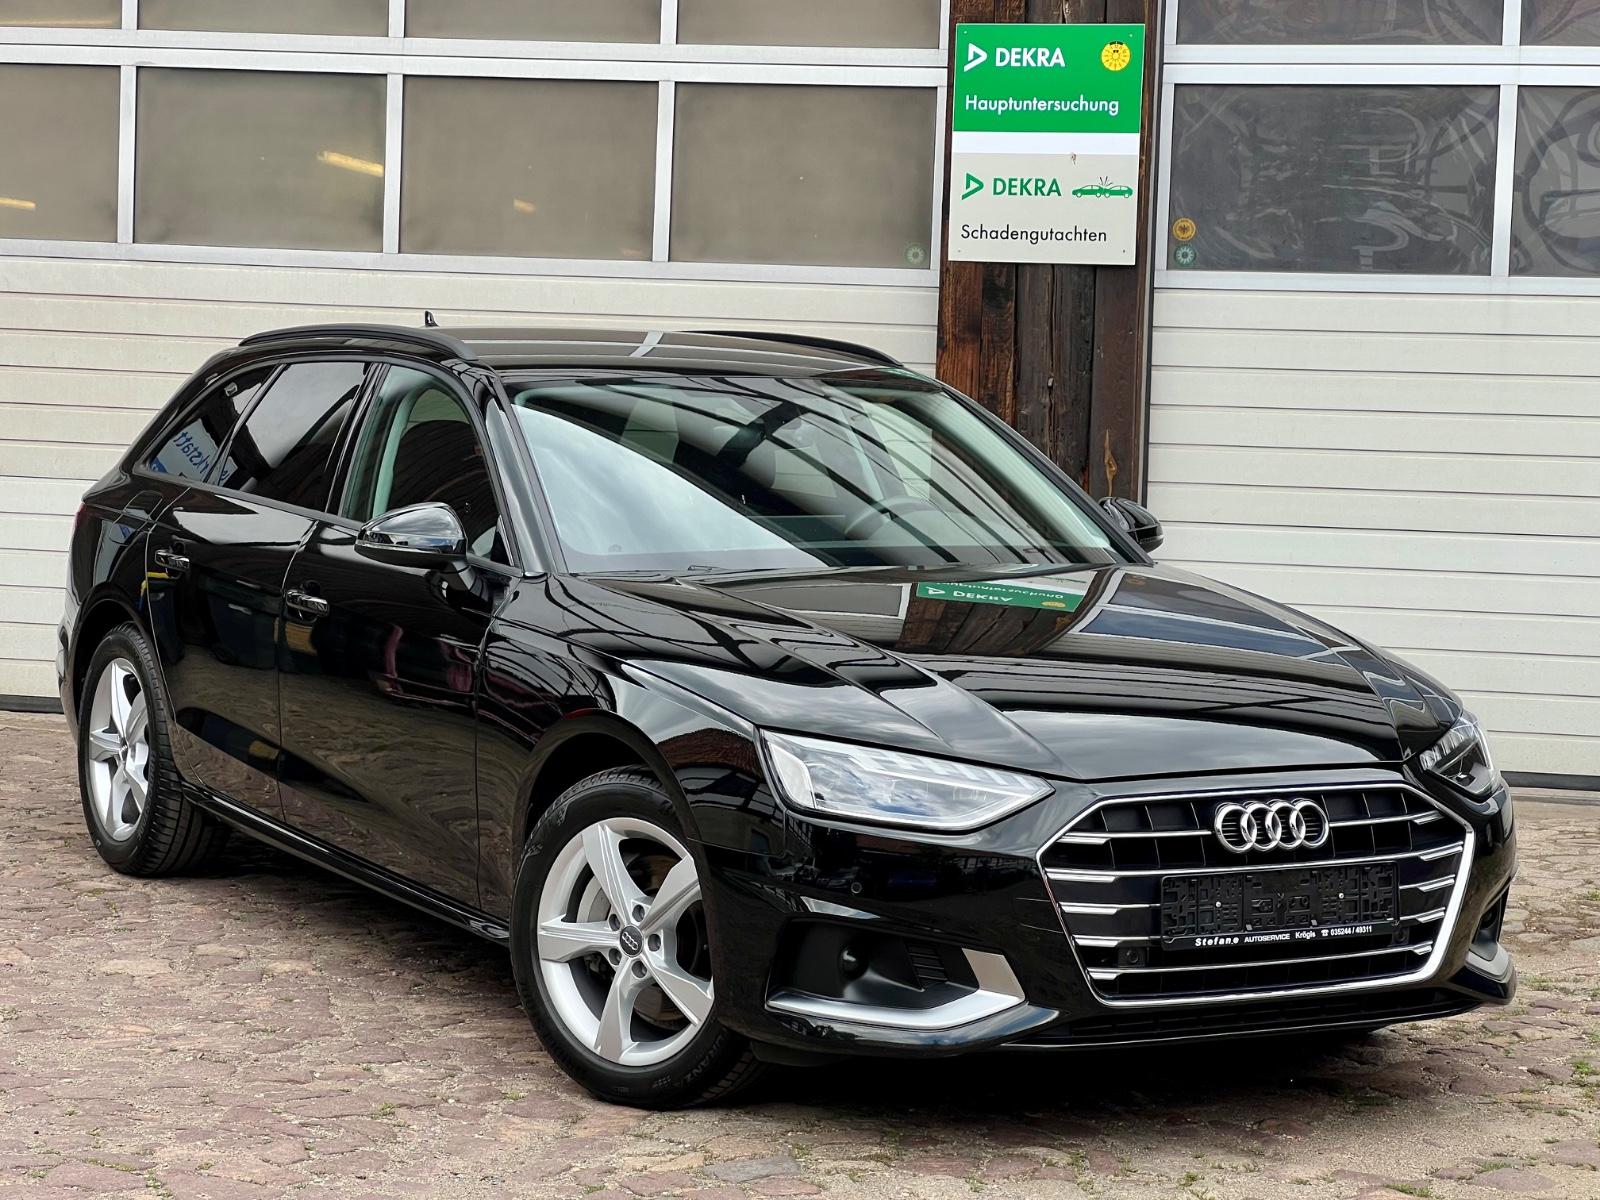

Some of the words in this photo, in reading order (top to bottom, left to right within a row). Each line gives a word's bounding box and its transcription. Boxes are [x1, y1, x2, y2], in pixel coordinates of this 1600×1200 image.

[995, 47, 1066, 67] DEKRA
[965, 94, 1119, 116] Hauptuntersuchung
[992, 178, 1062, 197] DEKRA
[961, 224, 1107, 245] Schadengutachten
[1244, 933, 1290, 943] AUTOSERVICE
